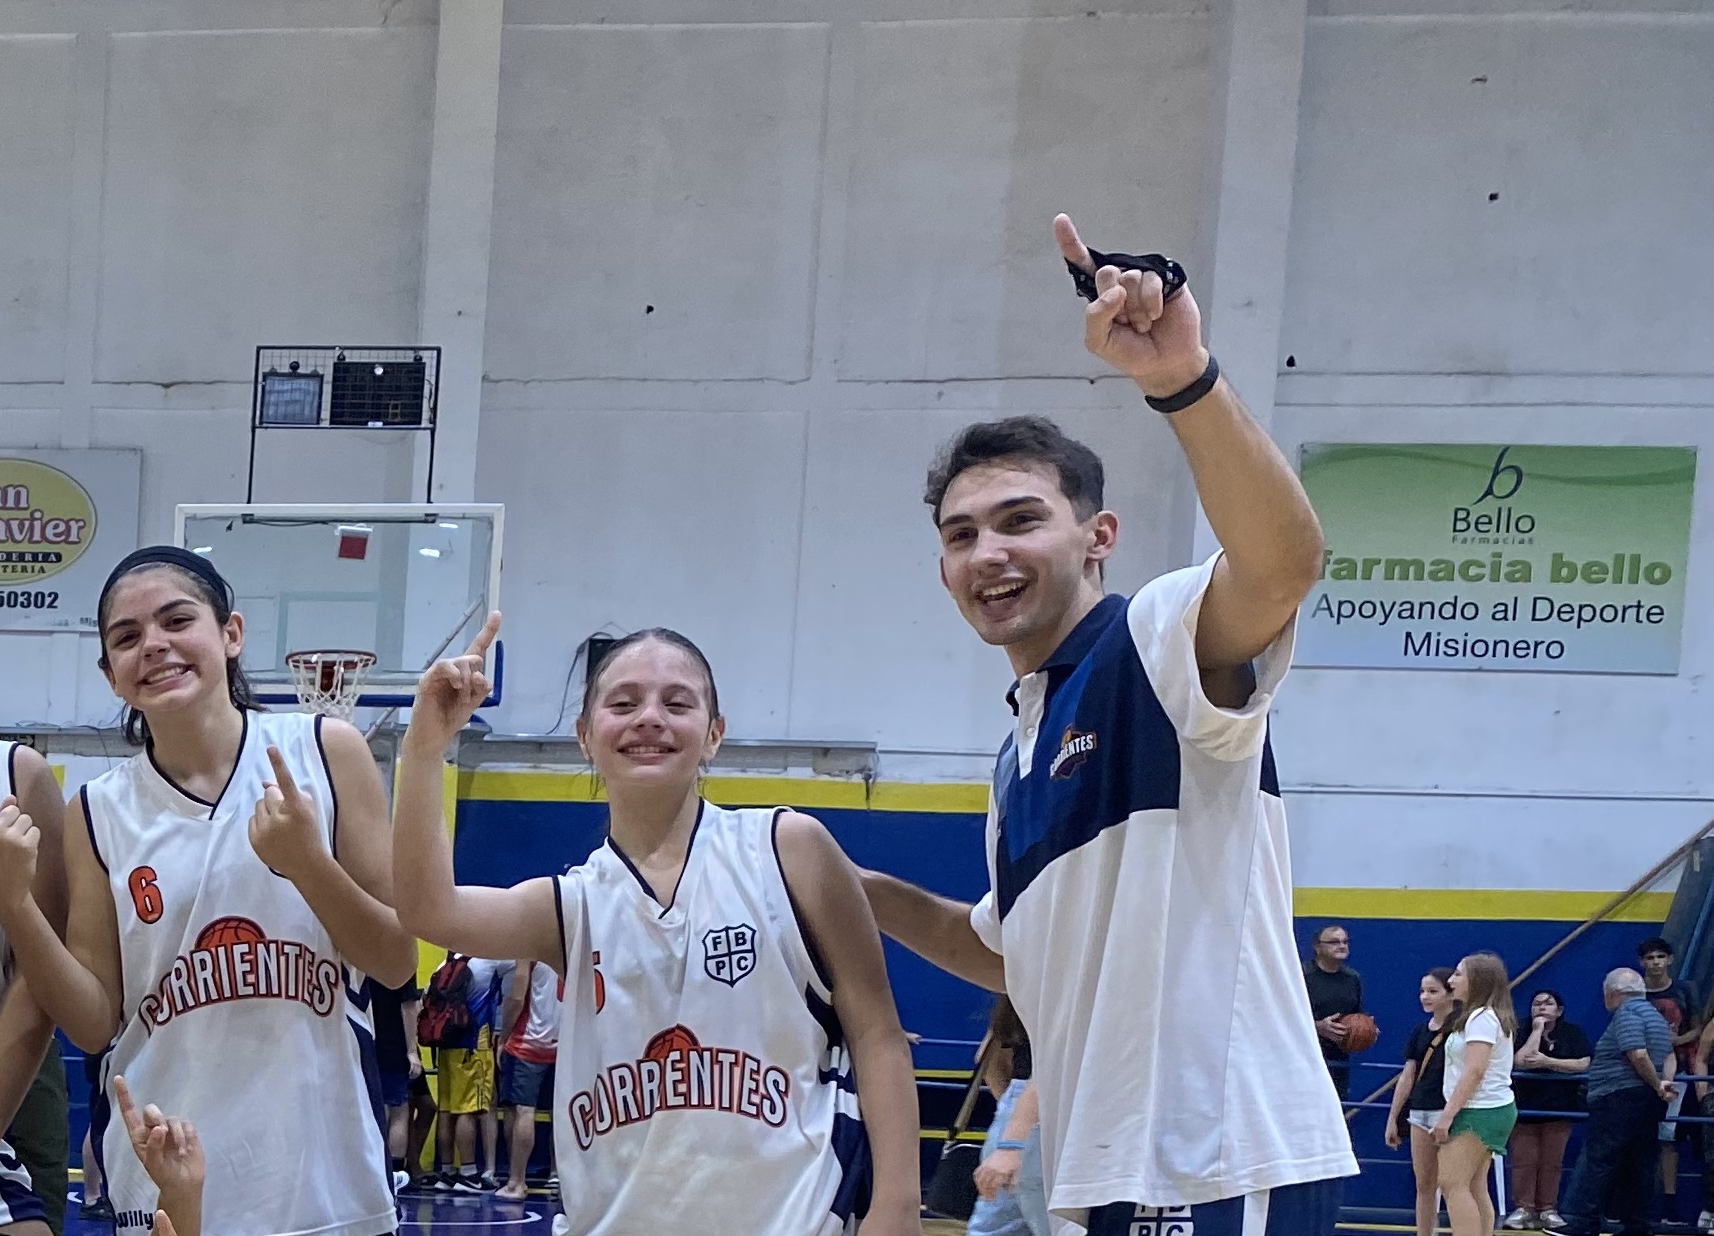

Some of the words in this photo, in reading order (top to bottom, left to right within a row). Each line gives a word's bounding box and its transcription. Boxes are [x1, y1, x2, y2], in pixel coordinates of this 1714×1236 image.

[1452, 506, 1537, 534] Bello
[1451, 535, 1536, 545] Farmacias
[1320, 550, 1533, 584] farmacia
[1550, 552, 1673, 587] bello
[1311, 594, 1480, 626] Apoyando
[1491, 596, 1519, 622] al
[1531, 596, 1666, 629] Deporte
[1403, 631, 1566, 661] Misionero
[128, 866, 164, 924] 6
